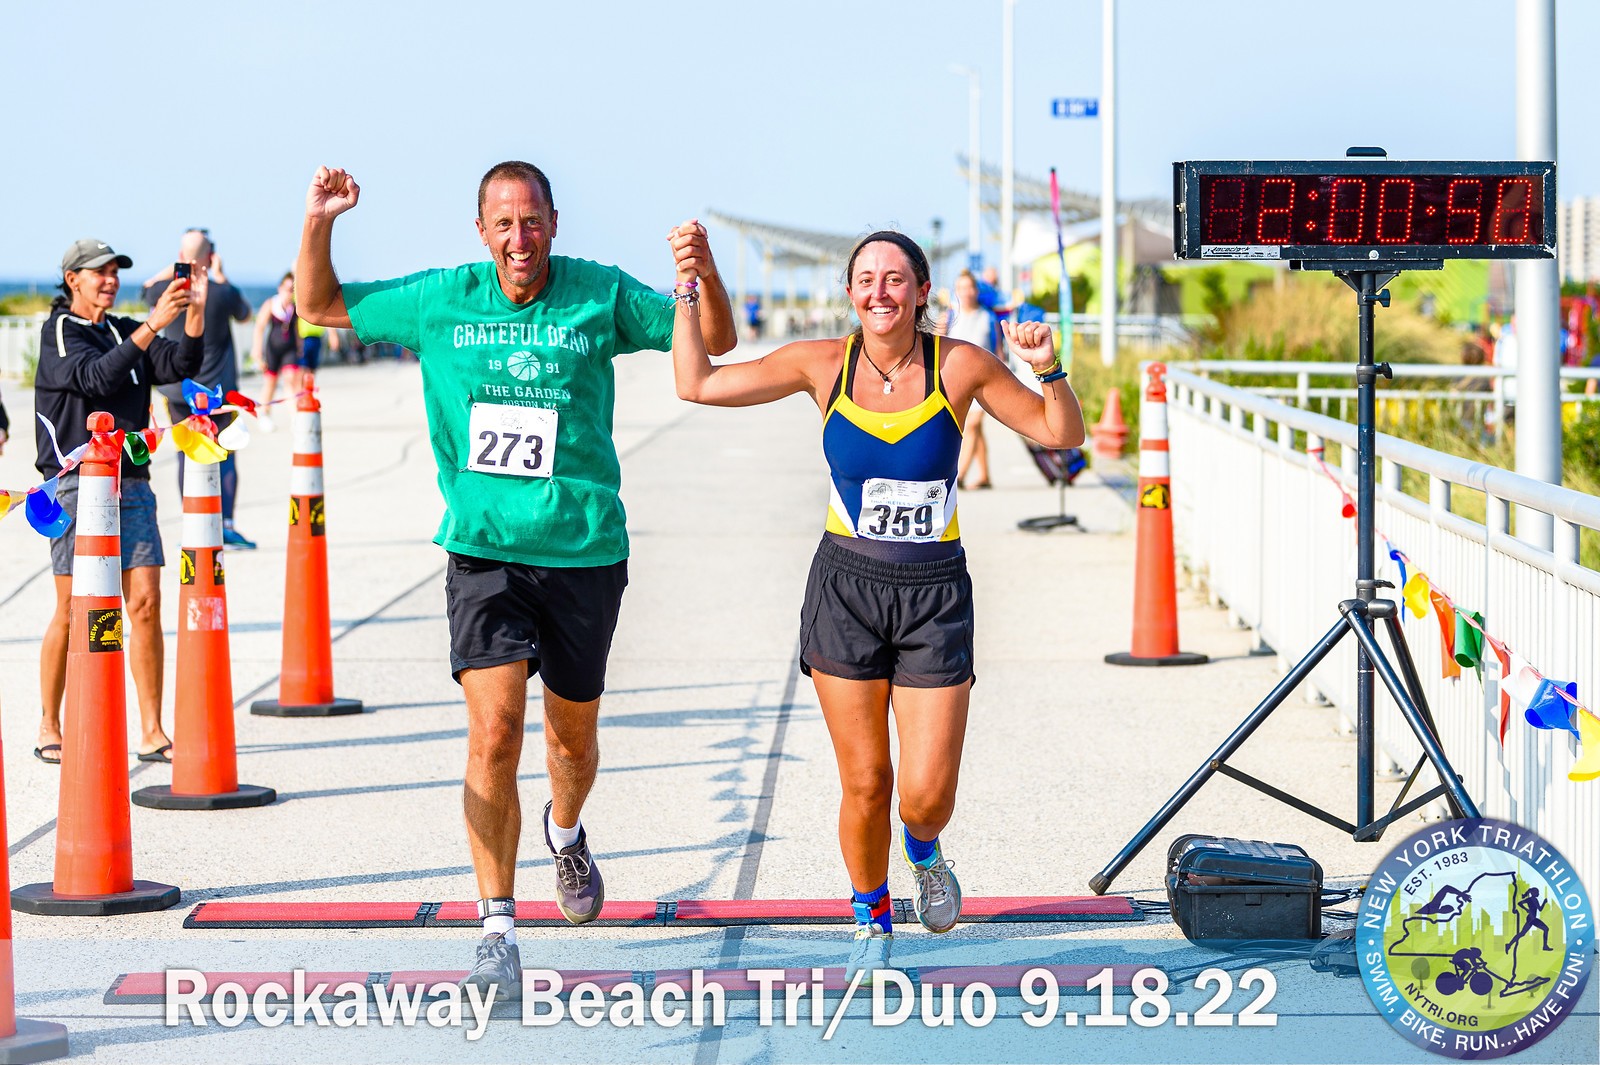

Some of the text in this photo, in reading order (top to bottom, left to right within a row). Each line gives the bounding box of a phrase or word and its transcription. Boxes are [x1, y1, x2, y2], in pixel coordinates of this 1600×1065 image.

[454, 323, 590, 356] GRATEFUL DEAD
[488, 359, 560, 374] 19 91
[482, 384, 571, 400] THE GARDEN
[477, 430, 543, 470] 273
[869, 505, 933, 537] 359
[90, 611, 114, 641] NEW YORK
